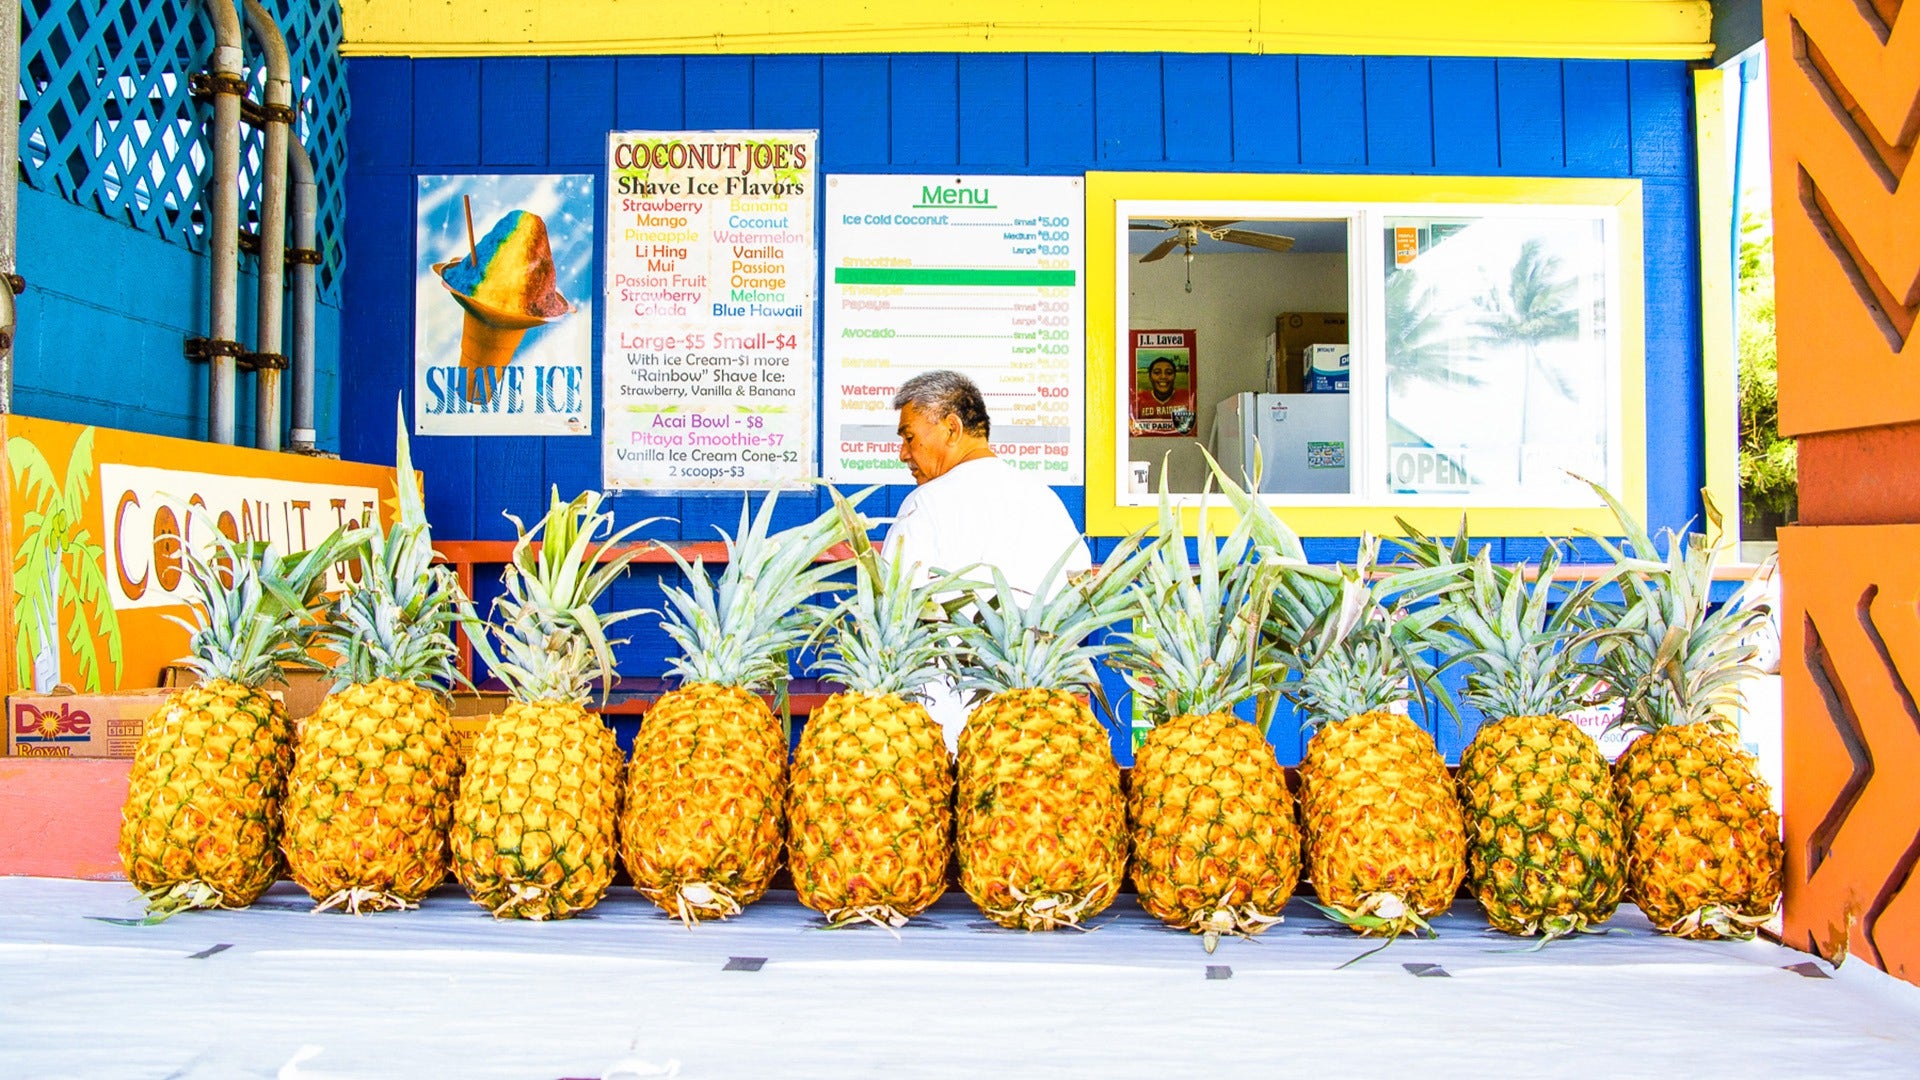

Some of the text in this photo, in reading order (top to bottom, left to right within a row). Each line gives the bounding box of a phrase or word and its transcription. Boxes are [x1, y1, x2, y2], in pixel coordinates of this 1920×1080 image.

[615, 143, 806, 175] COCONUT JOE'S
[618, 176, 804, 195] Shave Ice Flavors
[922, 185, 989, 204] Menu
[622, 198, 703, 214] Strawberry
[730, 198, 788, 213] Banana
[637, 214, 688, 229] Mango
[729, 215, 789, 229] Coconut
[842, 214, 948, 225] Ice Cold Coconut
[1038, 216, 1069, 227] $5.00
[625, 229, 699, 243] Pineapple
[714, 230, 804, 244] Watermelon
[1003, 232, 1036, 240] Medium
[635, 245, 687, 260] Li Hing
[733, 246, 784, 259] Vanilla
[1012, 247, 1036, 255] Large
[648, 259, 675, 272] Mui
[732, 260, 785, 274] Passion
[615, 274, 706, 287] Passion Fruit
[730, 275, 786, 290] Orange
[621, 289, 701, 303] Strawberry
[731, 289, 785, 302] Melona
[635, 303, 686, 316] Colada
[713, 303, 802, 317] Blue Hawaii
[842, 328, 896, 338] Avocado
[1140, 334, 1183, 345] J.L. Lavea
[620, 332, 797, 351] Large-$5 Small-$4
[627, 353, 659, 366] With
[685, 353, 749, 366] Cream-$1
[754, 357, 790, 366] more
[713, 369, 757, 382] Shave
[762, 370, 785, 382] Ice:
[425, 365, 582, 415] SHAVE ICE
[620, 385, 796, 398] Strawberry, Vanilla & Banana
[652, 414, 686, 428] Acai
[691, 414, 730, 428] Bowl
[746, 415, 764, 430] $8
[631, 431, 785, 448] Pitaya Smoothie-$7
[617, 449, 798, 463] Vanilla Ice Cream Cone-$2
[841, 443, 863, 453] Cut
[1019, 445, 1041, 456] per
[1044, 444, 1069, 456] bag
[1019, 459, 1042, 470] per
[1044, 459, 1069, 471] bag
[1396, 453, 1467, 484] OPEN
[669, 466, 745, 479] 2 scoops-$3
[15, 703, 91, 738] Dole
